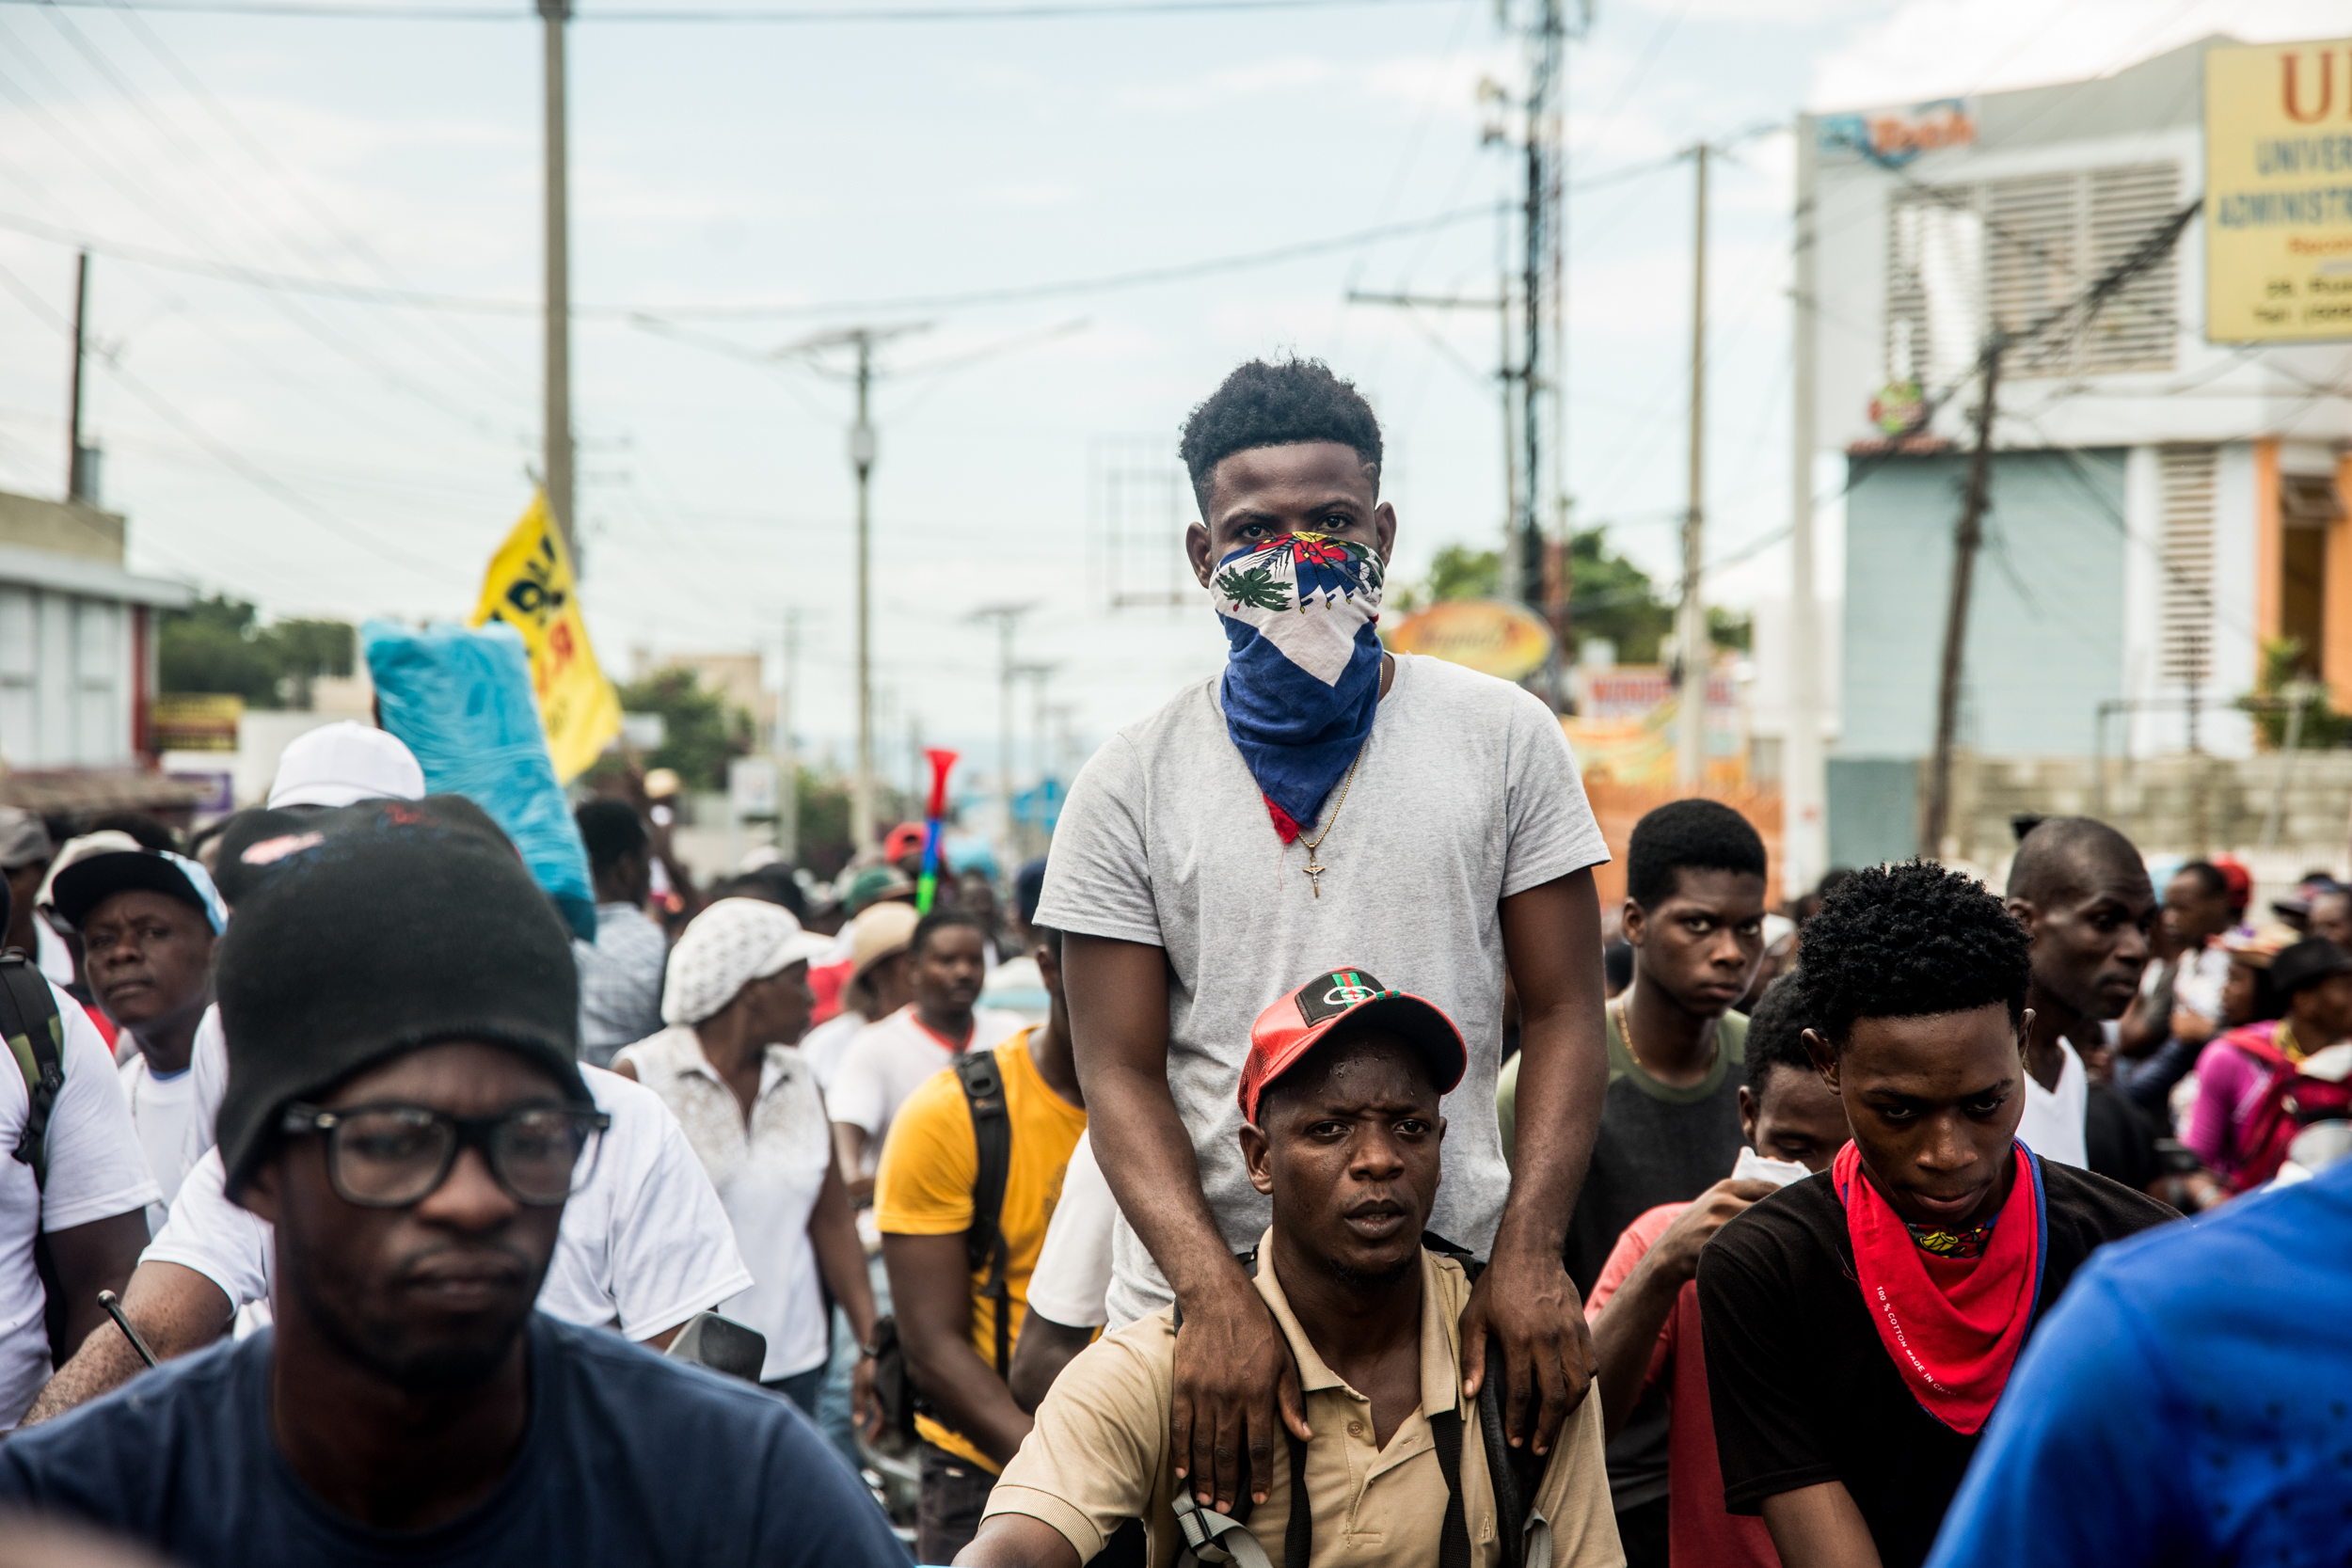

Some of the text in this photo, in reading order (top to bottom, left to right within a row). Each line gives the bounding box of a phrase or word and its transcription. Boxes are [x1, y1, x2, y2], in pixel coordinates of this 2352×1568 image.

[2279, 50, 2352, 125] U
[1877, 1286, 1886, 1301] 100
[1883, 1303, 1891, 1311] %
[1887, 1312, 1907, 1347] COTTON
[1906, 1350, 1925, 1372] MADE
[1923, 1372, 1933, 1383] IN
